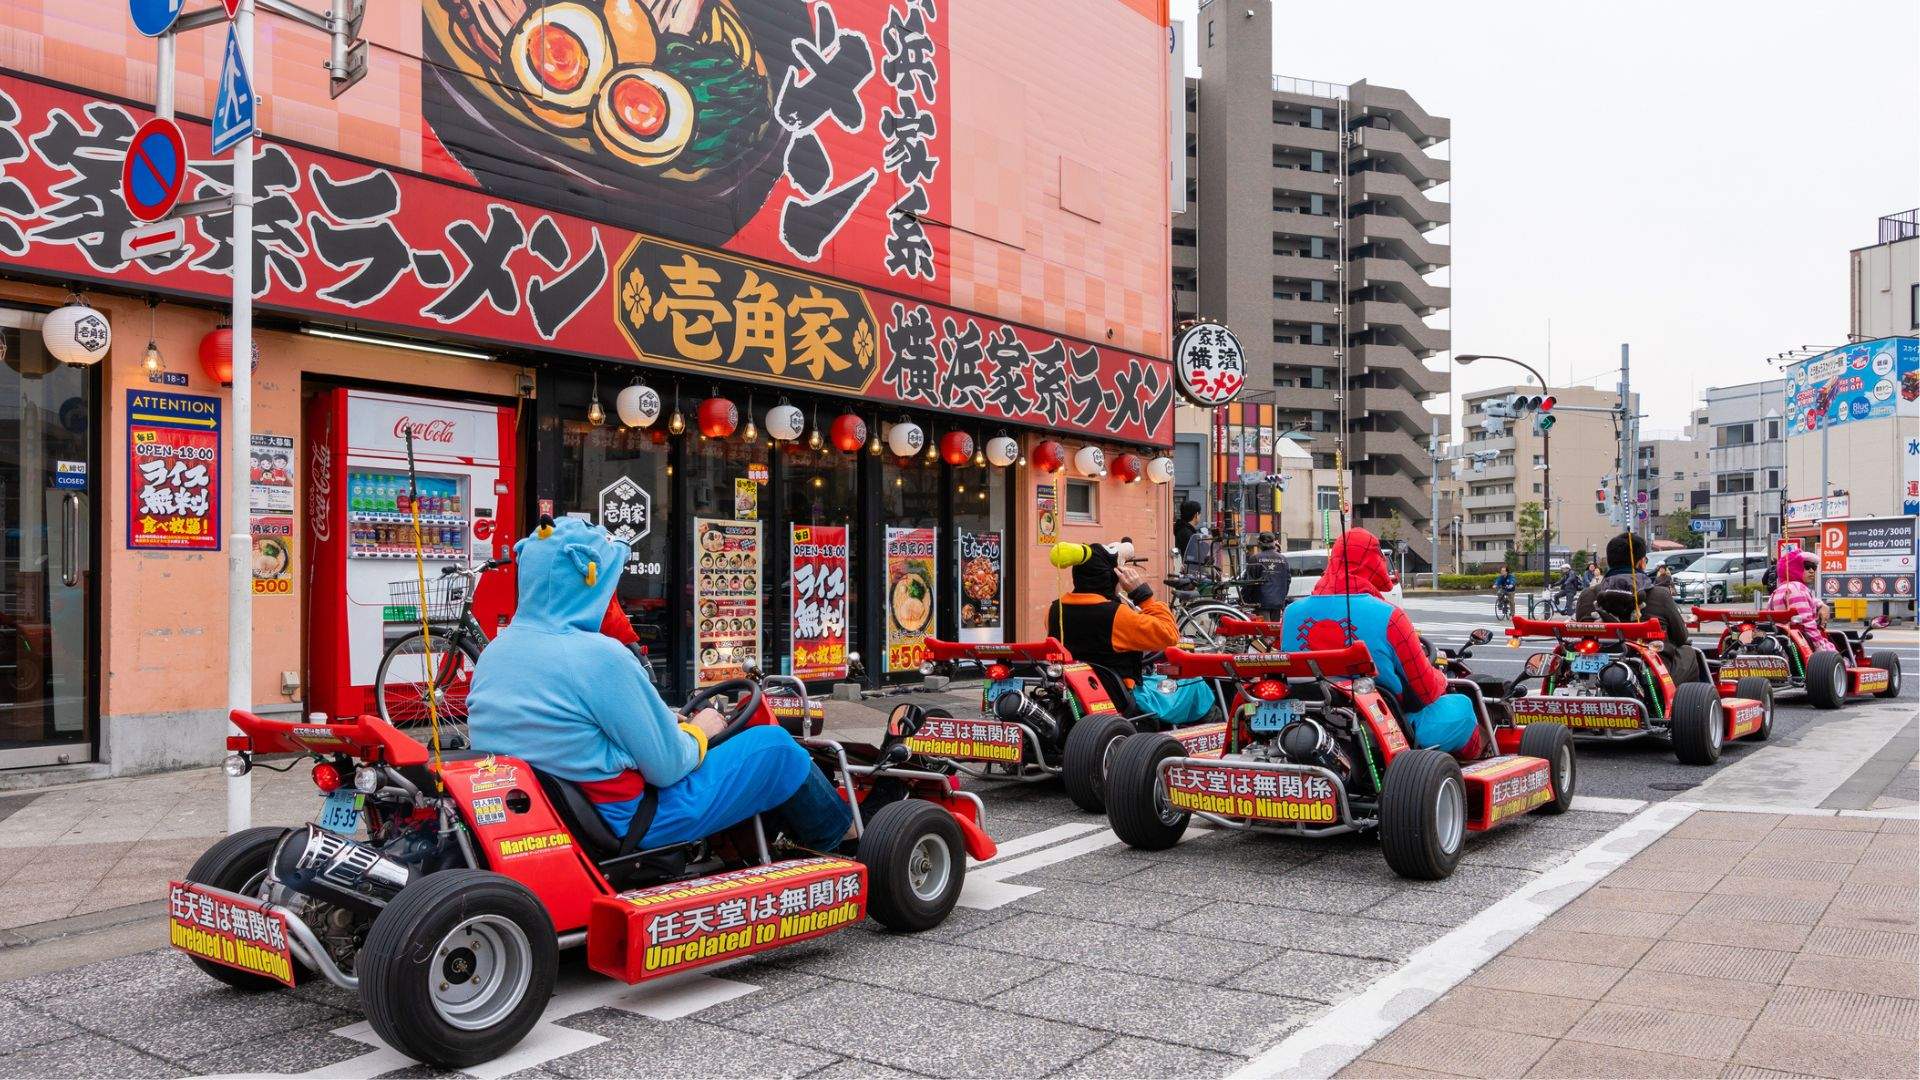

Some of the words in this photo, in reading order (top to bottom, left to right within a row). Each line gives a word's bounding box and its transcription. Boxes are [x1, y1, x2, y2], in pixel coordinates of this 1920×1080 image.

[880, 0, 940, 281] 浜家系
[0, 88, 609, 342] 家系ラーメン
[652, 254, 852, 381] 壱角家
[1199, 326, 1227, 347] 家系
[166, 374, 186, 384] 18-3
[882, 302, 1174, 438] 横浜家系ラーメン
[1191, 371, 1244, 401] ラーメン
[132, 395, 215, 414] ATTENTION
[136, 432, 155, 442] 毎日
[393, 416, 456, 444] Coca-Cola
[58, 477, 85, 485] CLOSED
[138, 459, 209, 488] ライス
[140, 485, 209, 517] 無料
[311, 440, 331, 542] Coca-Cola
[604, 501, 645, 524] 壱角家
[795, 530, 809, 541] 毎日
[1826, 561, 1842, 570] 24h
[794, 563, 845, 600] ライス
[794, 598, 845, 639] 無料
[890, 644, 923, 668] ¥50
[1512, 700, 1637, 717] 任天堂は無関係
[1571, 715, 1583, 726] to
[1584, 714, 1639, 729] Nintendo
[906, 736, 958, 755] Unrelated
[960, 740, 971, 756] to
[973, 741, 1020, 761] Nintendo
[1167, 766, 1332, 799] 任天堂は無関係
[329, 808, 358, 828] 15-39
[1169, 786, 1235, 814] Unrelated
[1236, 797, 1253, 816] to
[1256, 797, 1334, 821] Nintendo
[171, 885, 286, 950] 任天堂は無関係
[646, 873, 861, 945] 任天堂は無関係
[171, 917, 221, 960] Unrelated
[221, 936, 235, 963] to
[235, 938, 292, 982] Nintendo
[644, 927, 752, 971] Unrelated
[755, 922, 776, 944] to
[779, 901, 859, 940] Nintendo
